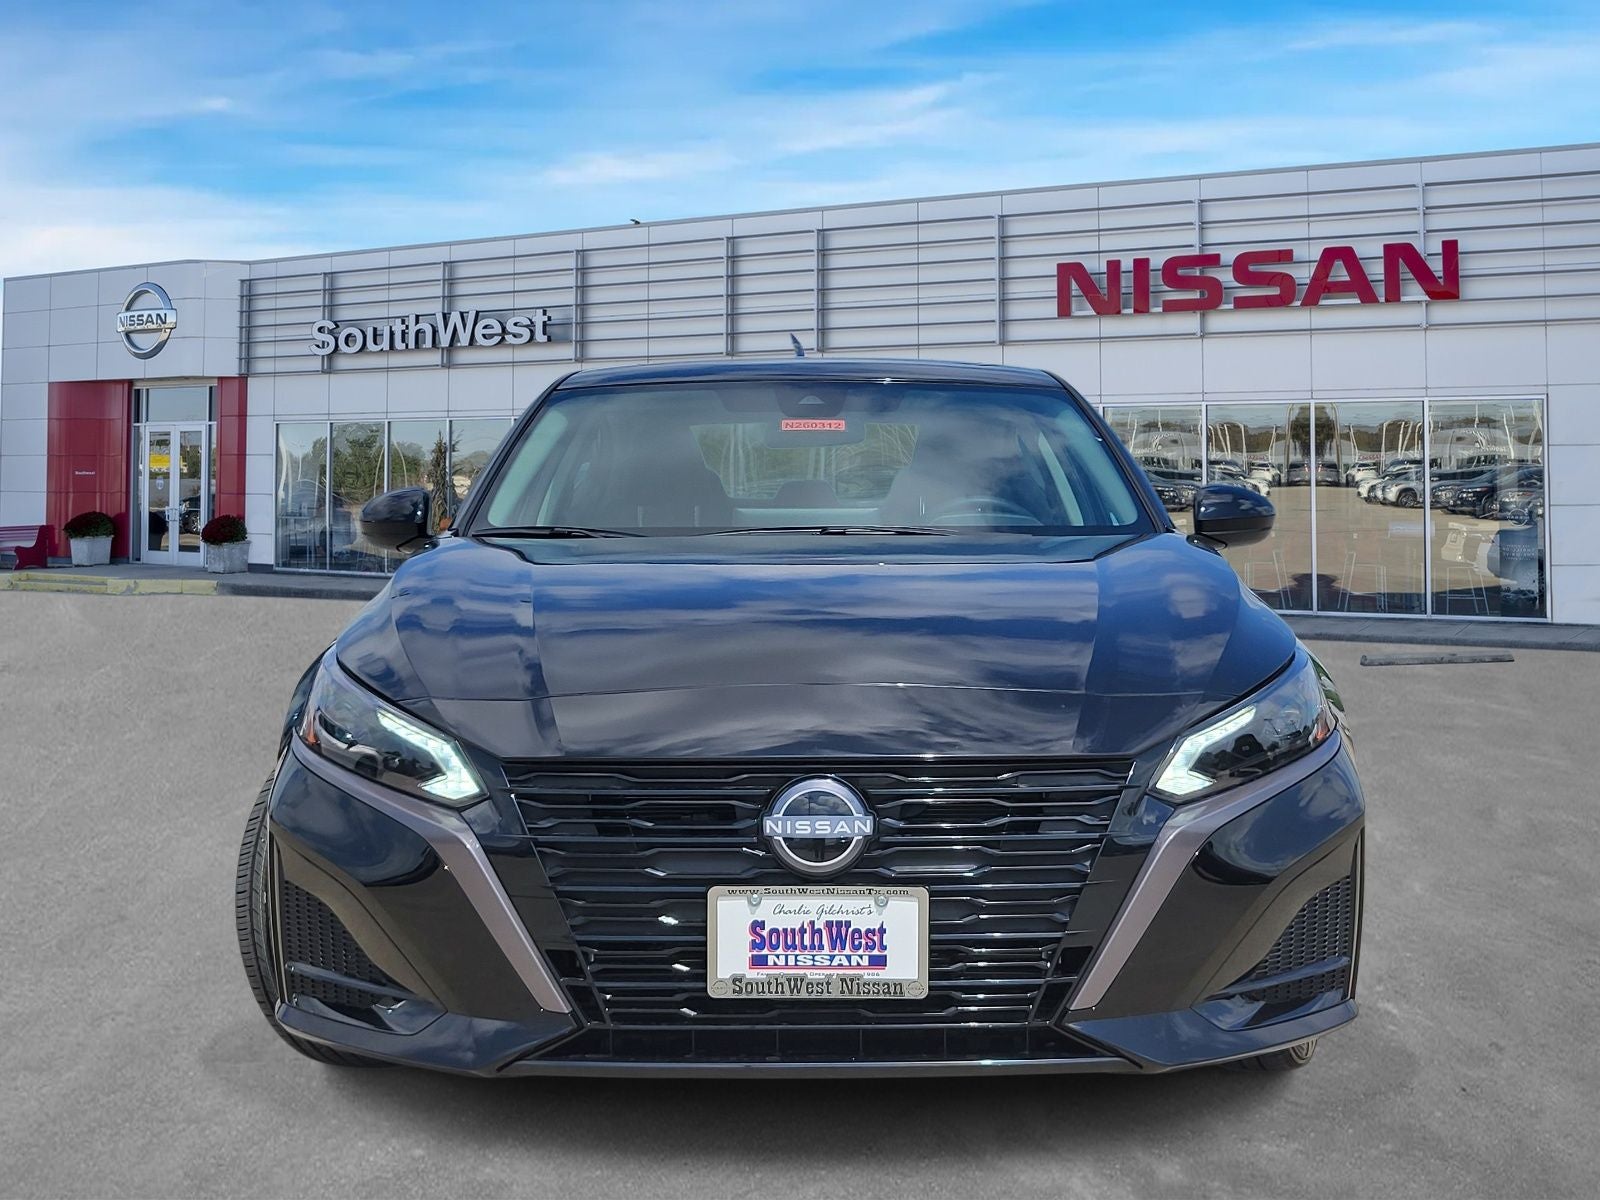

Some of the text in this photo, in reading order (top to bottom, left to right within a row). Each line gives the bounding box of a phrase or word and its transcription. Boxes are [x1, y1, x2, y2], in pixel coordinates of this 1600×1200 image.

[1056, 239, 1460, 318] NISSAN
[118, 313, 167, 328] NISSAN
[309, 309, 551, 356] SouthWest
[784, 421, 841, 430] N260312
[765, 819, 872, 835] NISSAN
[772, 903, 874, 920] Charlie Gilchrist's
[748, 919, 887, 952] SouthWest
[767, 954, 870, 966] NISSAN
[732, 977, 904, 995] SouthWest Nissan
